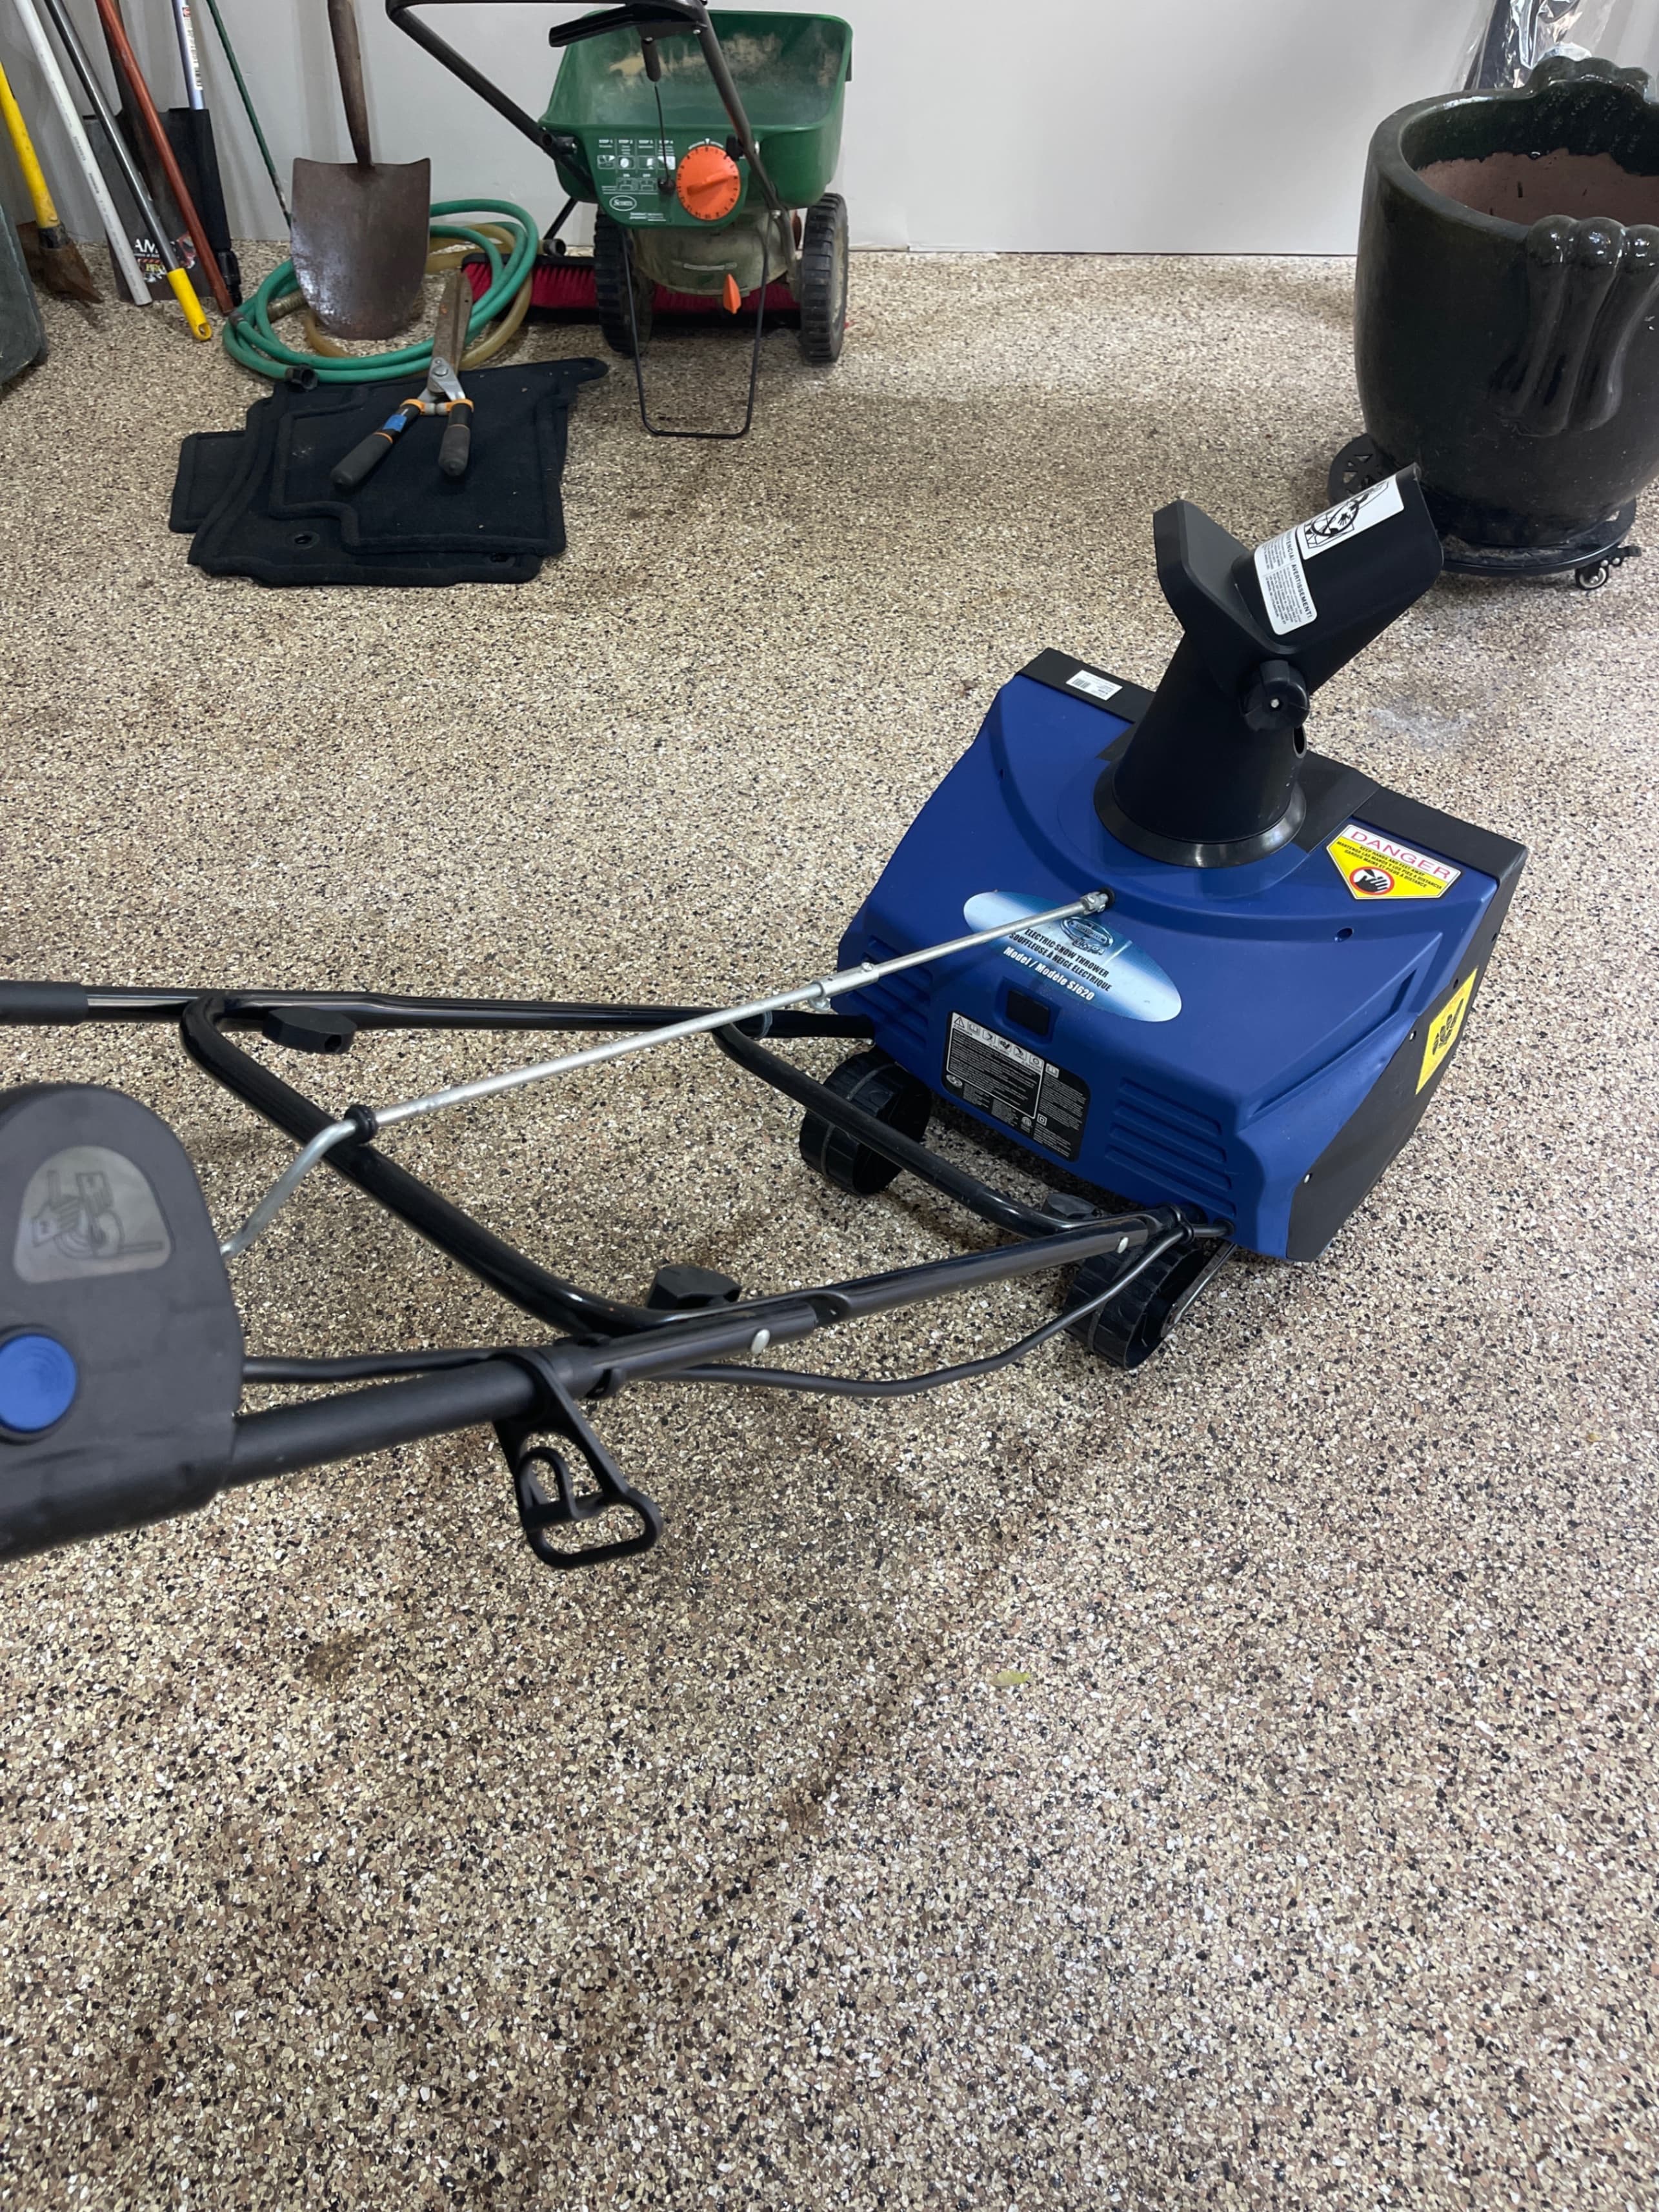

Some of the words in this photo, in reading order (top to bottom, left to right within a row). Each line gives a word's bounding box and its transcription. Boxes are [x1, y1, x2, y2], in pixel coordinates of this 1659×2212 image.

[1351, 831, 1451, 879] DANGER
[1003, 946, 1032, 965] Model
[1035, 963, 1069, 985] Modèle
[1067, 981, 1095, 1001] SJ620
[1009, 932, 1048, 956] SOUFFLEUSE
[1051, 954, 1074, 969] NEIGE
[1071, 964, 1112, 991] ÉLECTRIQUE
[1024, 928, 1056, 948] ELECTRIC
[1054, 944, 1077, 959] SNOW
[1076, 954, 1110, 978] THROWER
